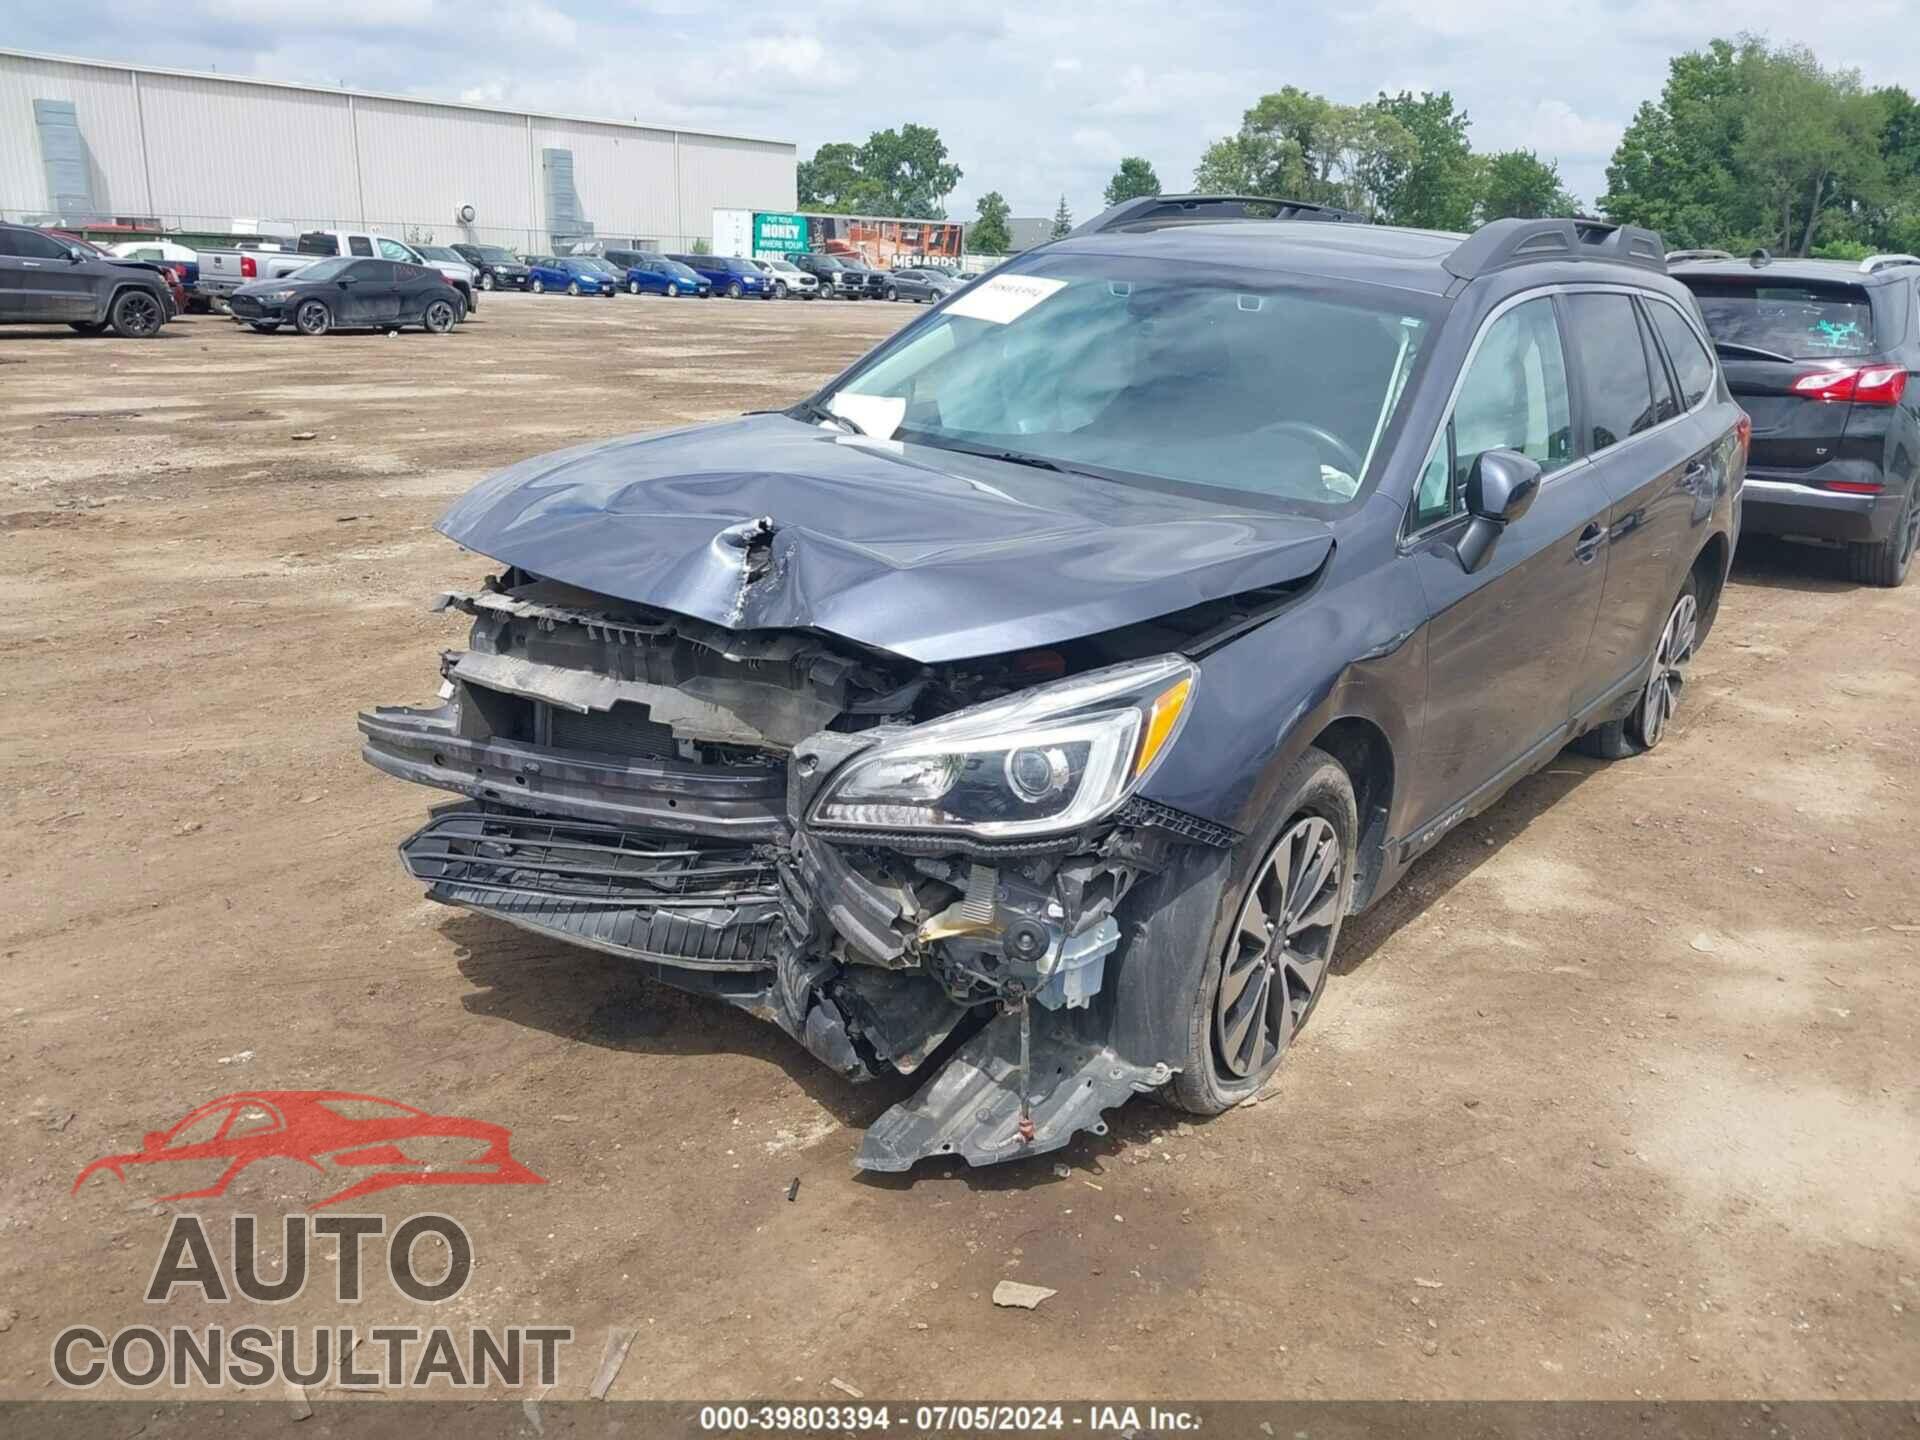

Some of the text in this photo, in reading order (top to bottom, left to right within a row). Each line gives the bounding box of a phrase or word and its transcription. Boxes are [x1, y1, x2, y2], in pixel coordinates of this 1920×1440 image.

[761, 223, 801, 240] MONEY
[784, 240, 804, 250] YOUR
[891, 254, 958, 269] MENARDS
